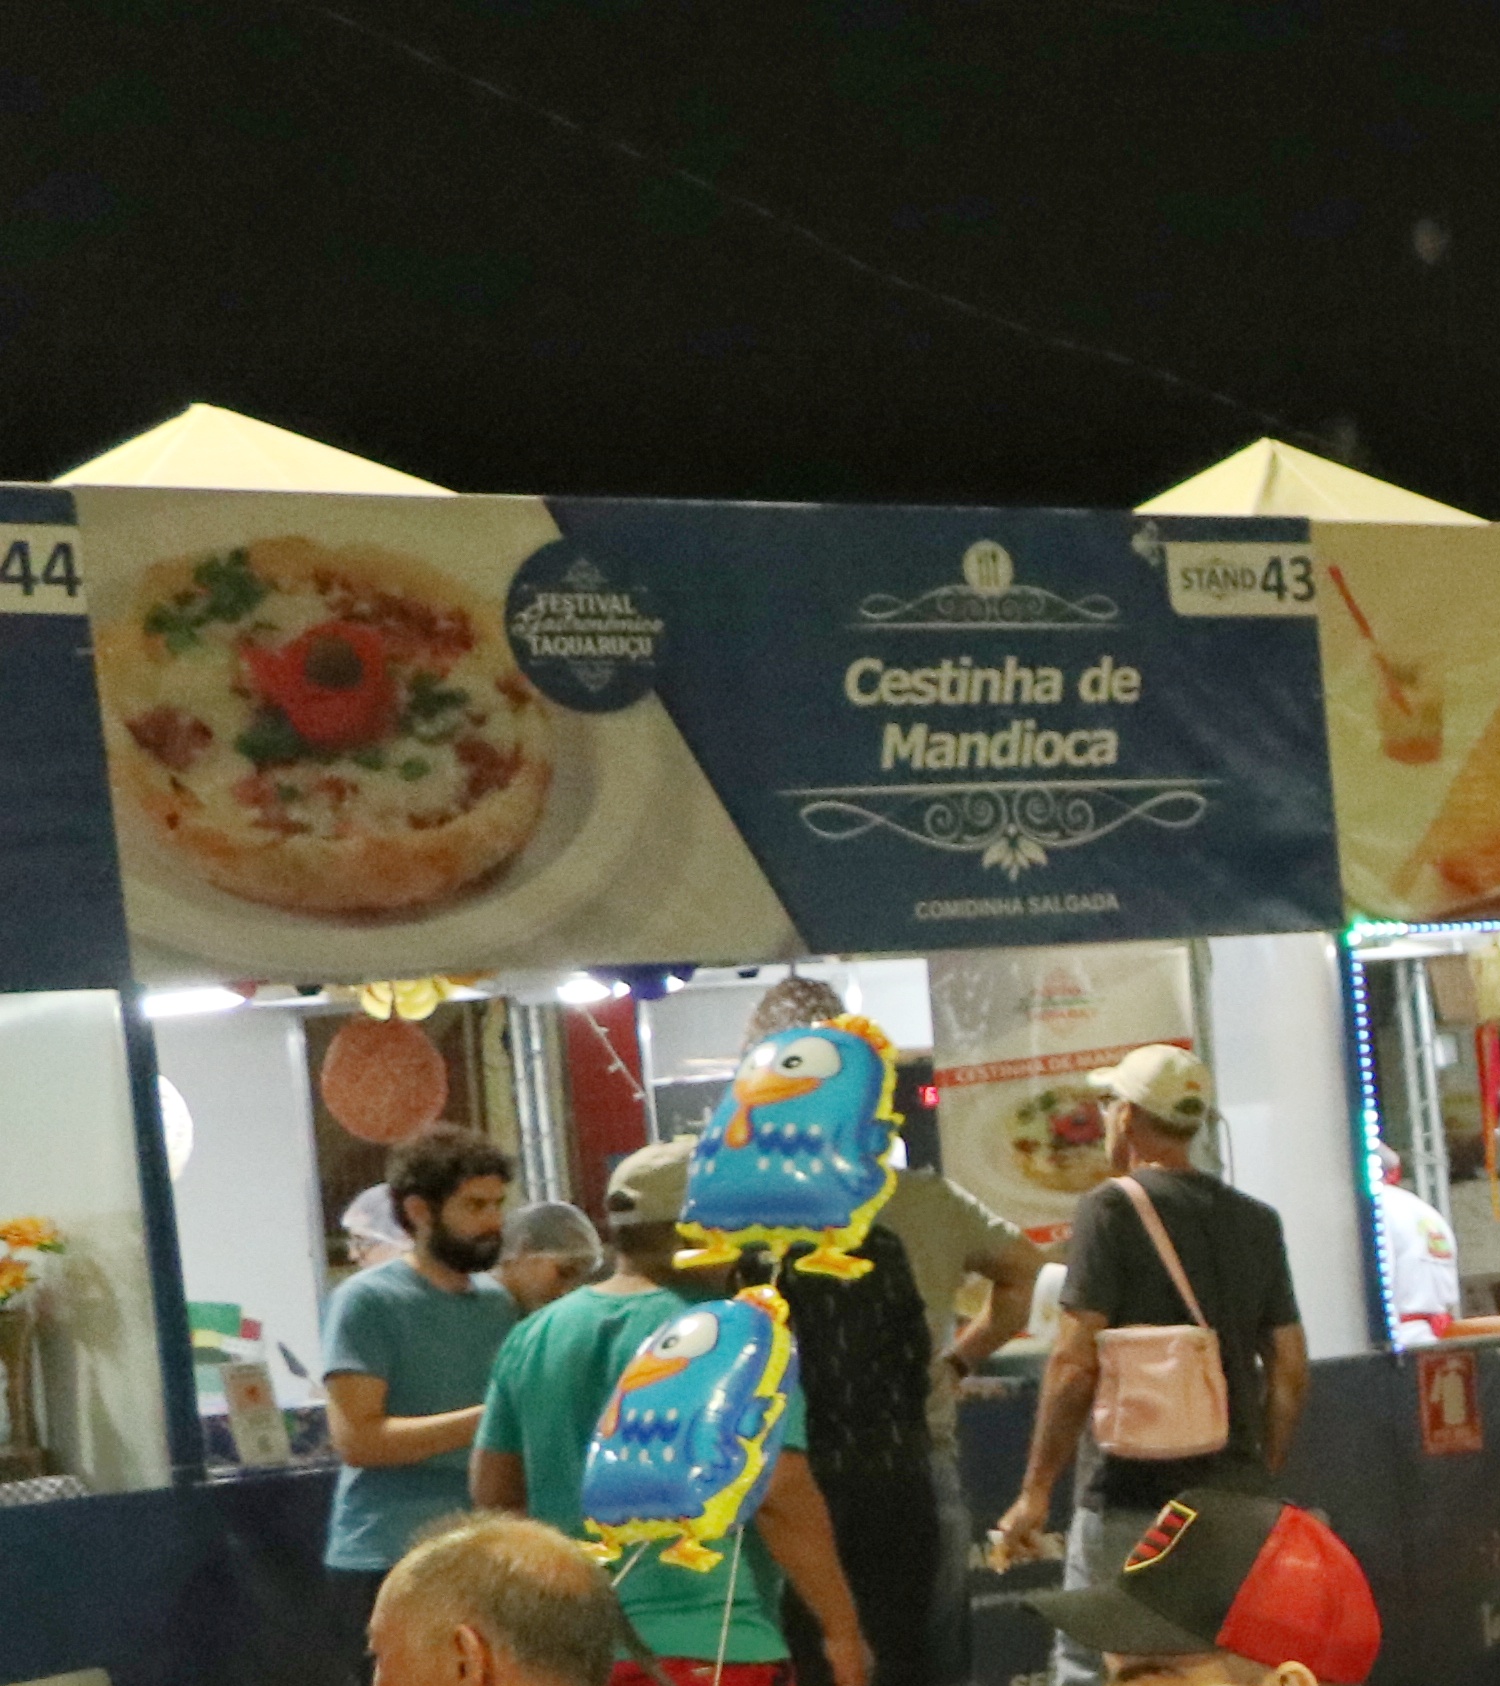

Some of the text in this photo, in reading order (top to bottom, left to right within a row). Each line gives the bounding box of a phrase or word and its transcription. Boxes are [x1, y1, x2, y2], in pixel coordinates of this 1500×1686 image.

[0, 541, 82, 598] 44
[1181, 555, 1317, 603] STAND 43
[536, 592, 634, 616] FESTIVAL
[527, 635, 654, 662] TAQUARUÇU
[843, 655, 1142, 706] Cestinha de
[879, 719, 1121, 772] Mandioca
[915, 892, 1120, 920] COMIDINHA SALGADA
